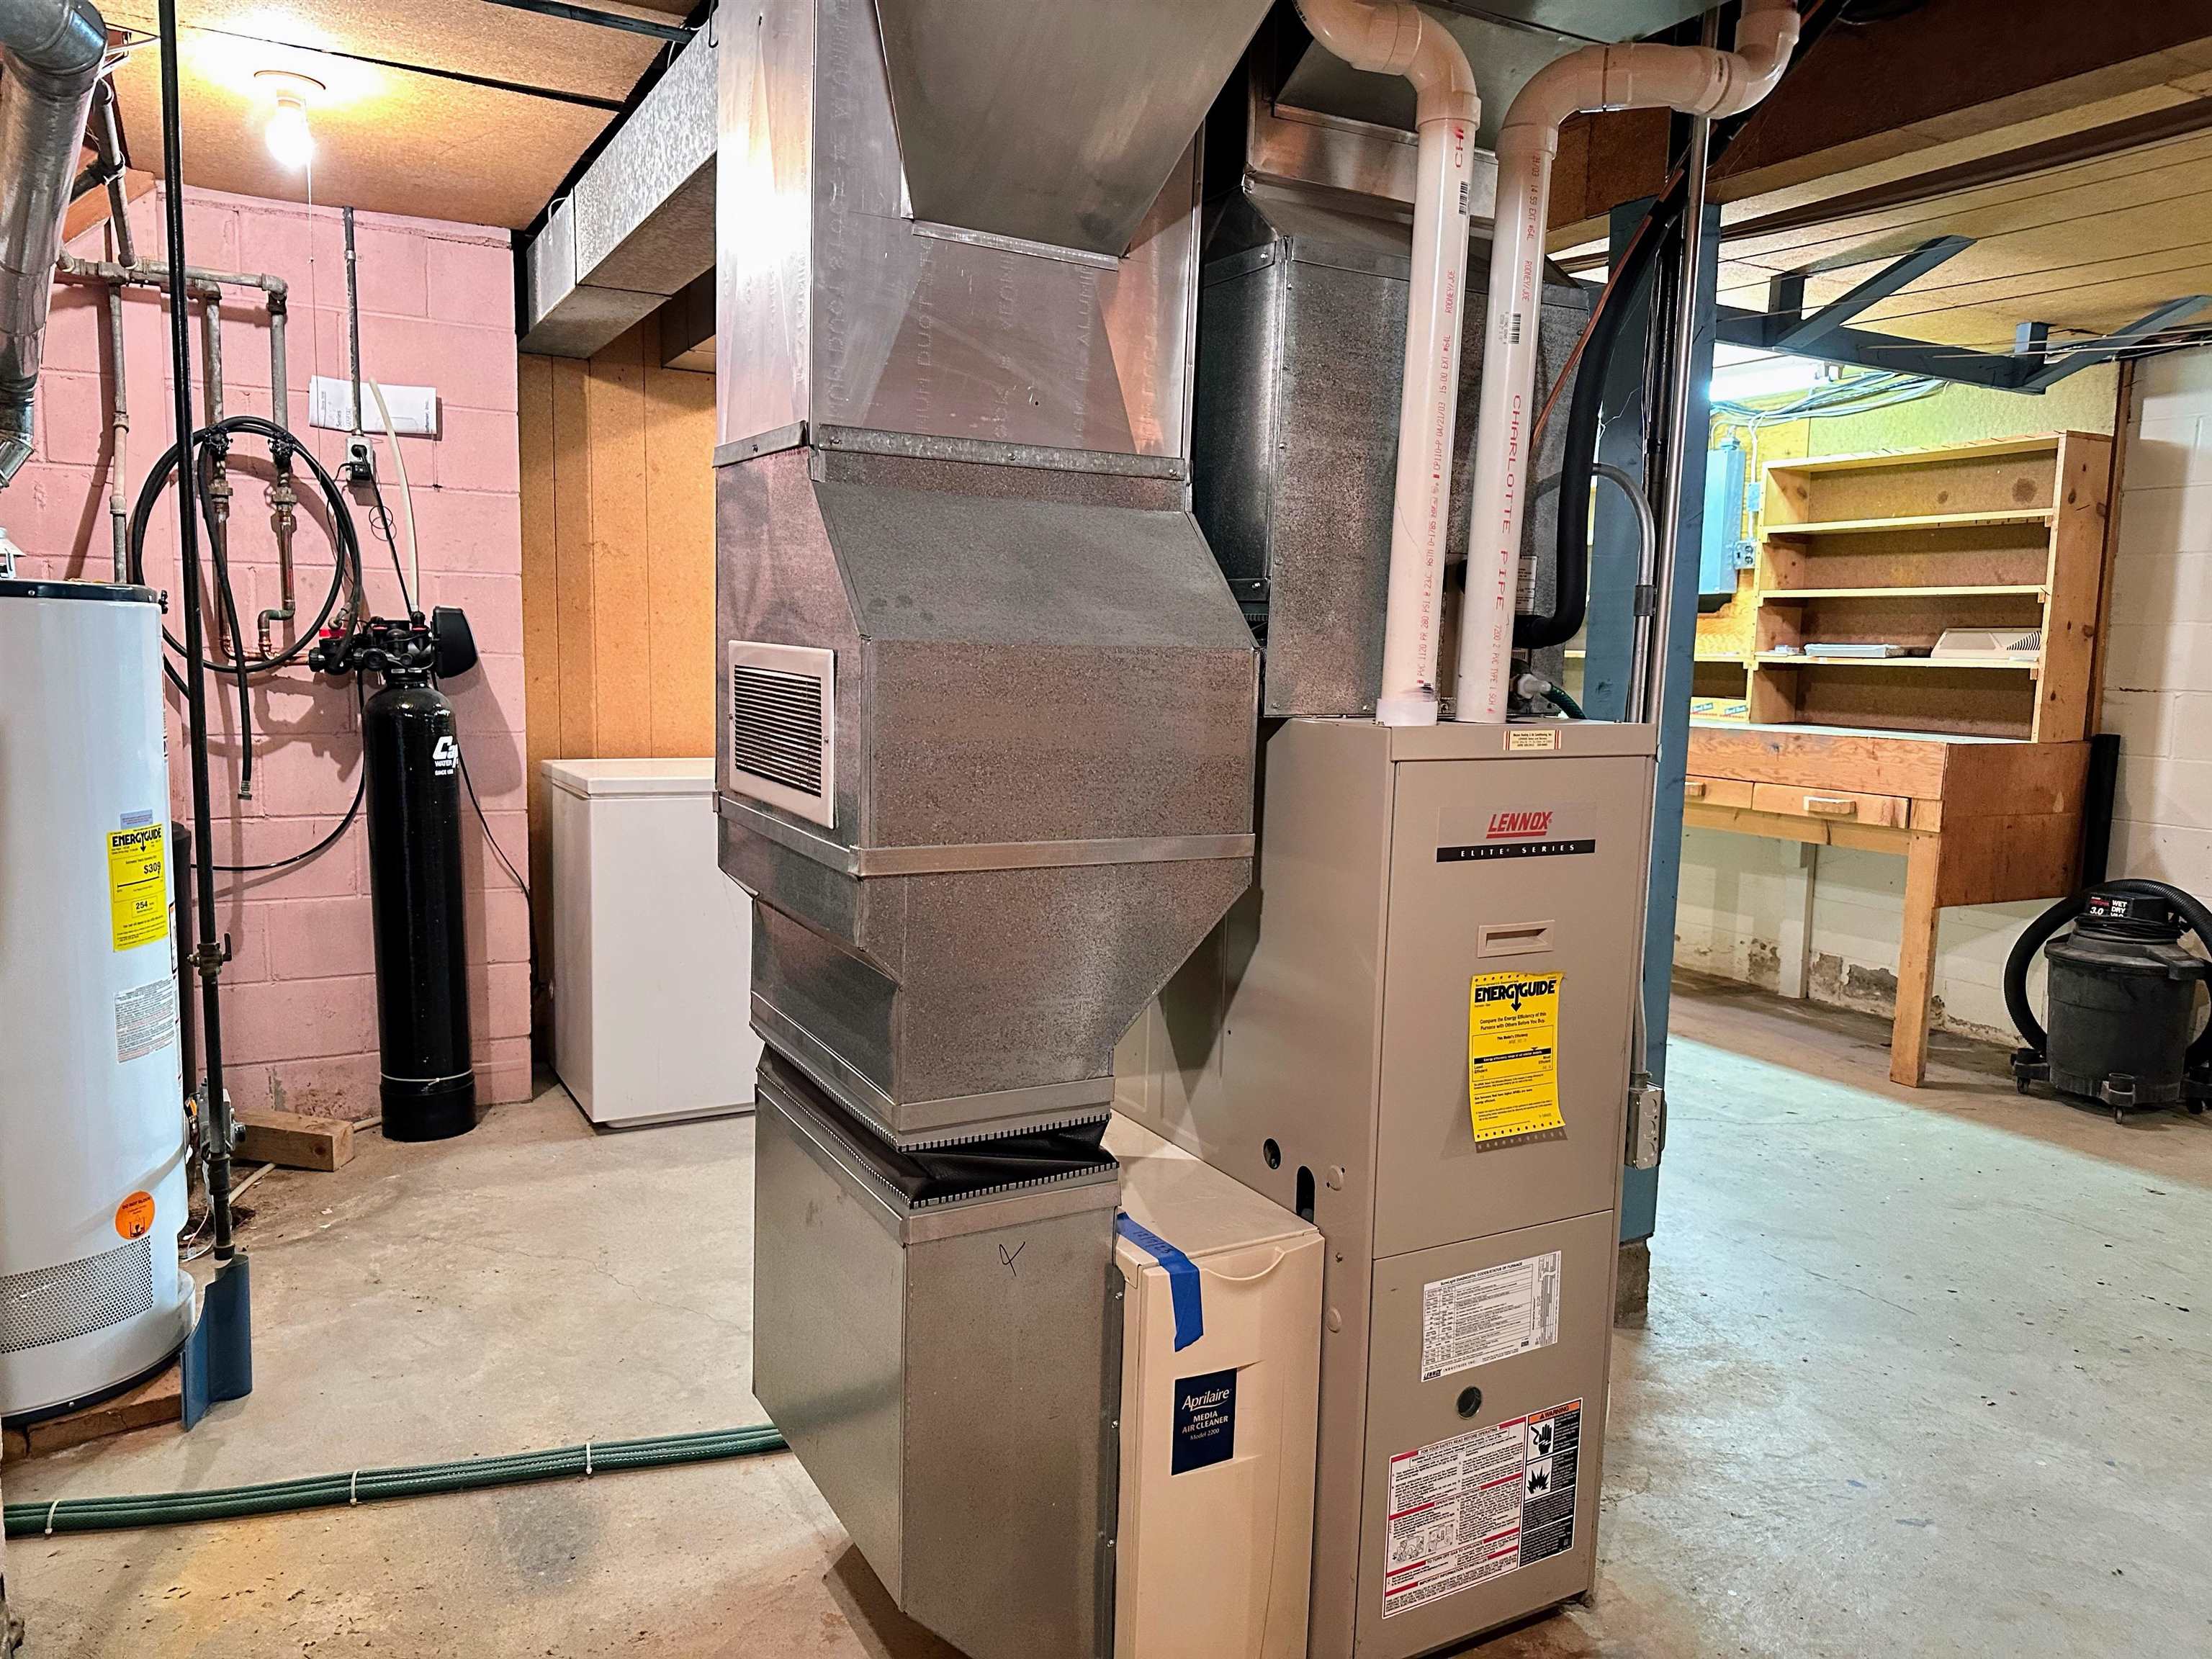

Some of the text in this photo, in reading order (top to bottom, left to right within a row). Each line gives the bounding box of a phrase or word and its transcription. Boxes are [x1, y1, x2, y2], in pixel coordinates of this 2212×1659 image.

[1521, 260, 1533, 302] RODNEY/JOE
[1444, 270, 1456, 314] RODNEY/JOE
[1495, 395, 1521, 610] CHARLOTTE PIPE
[1488, 811, 1553, 832] LENNOX
[112, 827, 161, 848] ENERGYGUIDE
[1461, 844, 1575, 857] ELITE SERIES
[135, 901, 148, 910] 254
[2090, 907, 2104, 915] 3.0
[1474, 979, 1557, 1004] ENERGYGUIDE
[1182, 1388, 1230, 1411] Aprilaire
[1193, 1411, 1218, 1423] MEDIA
[1545, 1405, 1569, 1418] WARNING
[1182, 1416, 1228, 1434] AIR CLEANER
